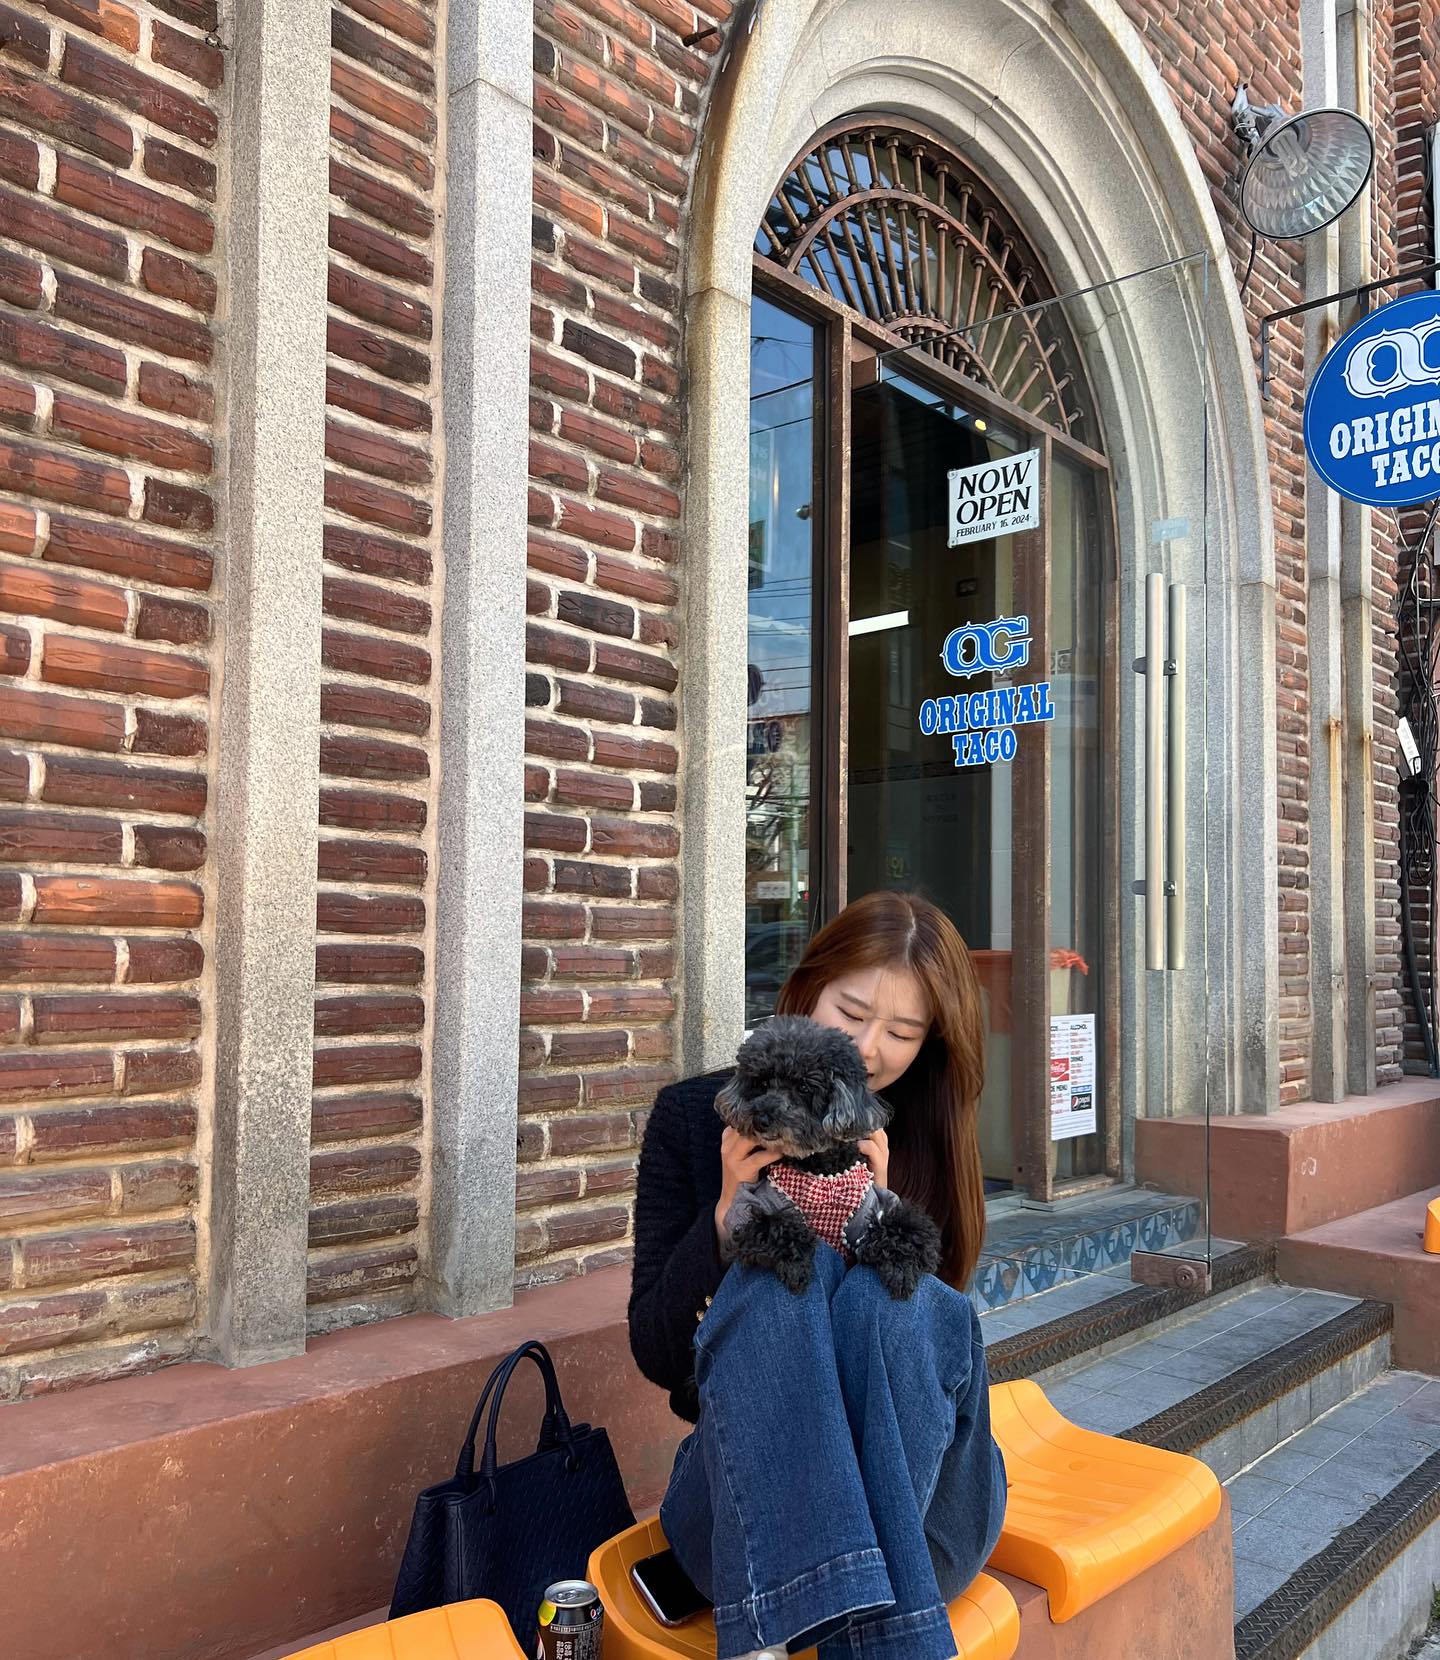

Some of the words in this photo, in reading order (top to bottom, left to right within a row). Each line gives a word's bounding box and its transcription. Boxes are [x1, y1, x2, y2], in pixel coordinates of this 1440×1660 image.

[957, 459, 1032, 500] NOW
[956, 485, 1032, 525] OPEN
[956, 521, 997, 538] FEBRUARY
[919, 682, 1055, 736] ORIGINAL
[952, 728, 1017, 767] TACO
